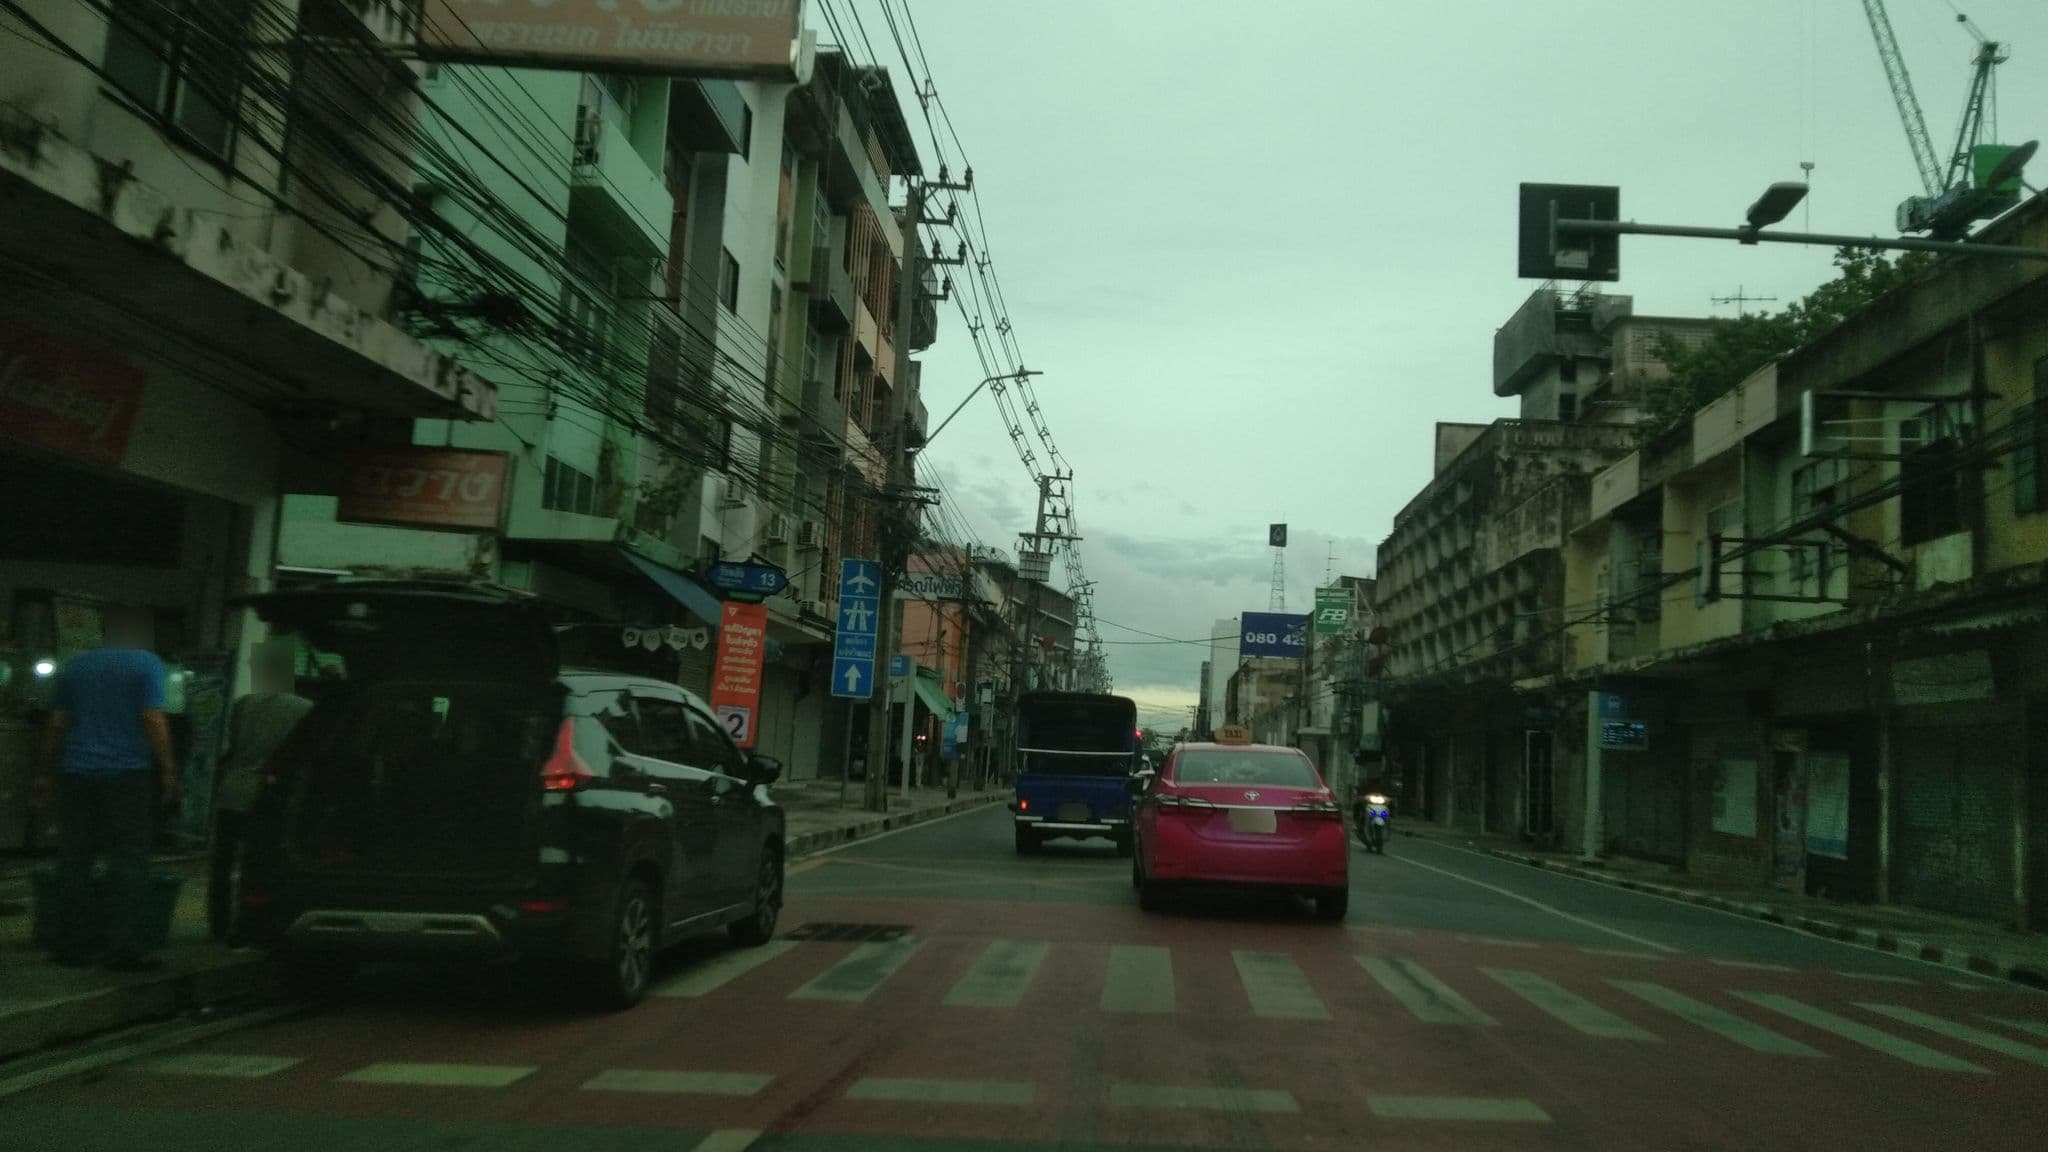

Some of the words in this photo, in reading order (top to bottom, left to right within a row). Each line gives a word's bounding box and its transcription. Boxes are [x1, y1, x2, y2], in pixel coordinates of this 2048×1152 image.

[760, 572, 776, 586] 13
[1318, 608, 1348, 621] FB
[1245, 631, 1277, 645] 080
[727, 712, 744, 739] 2
[1224, 729, 1243, 738] TAXI
